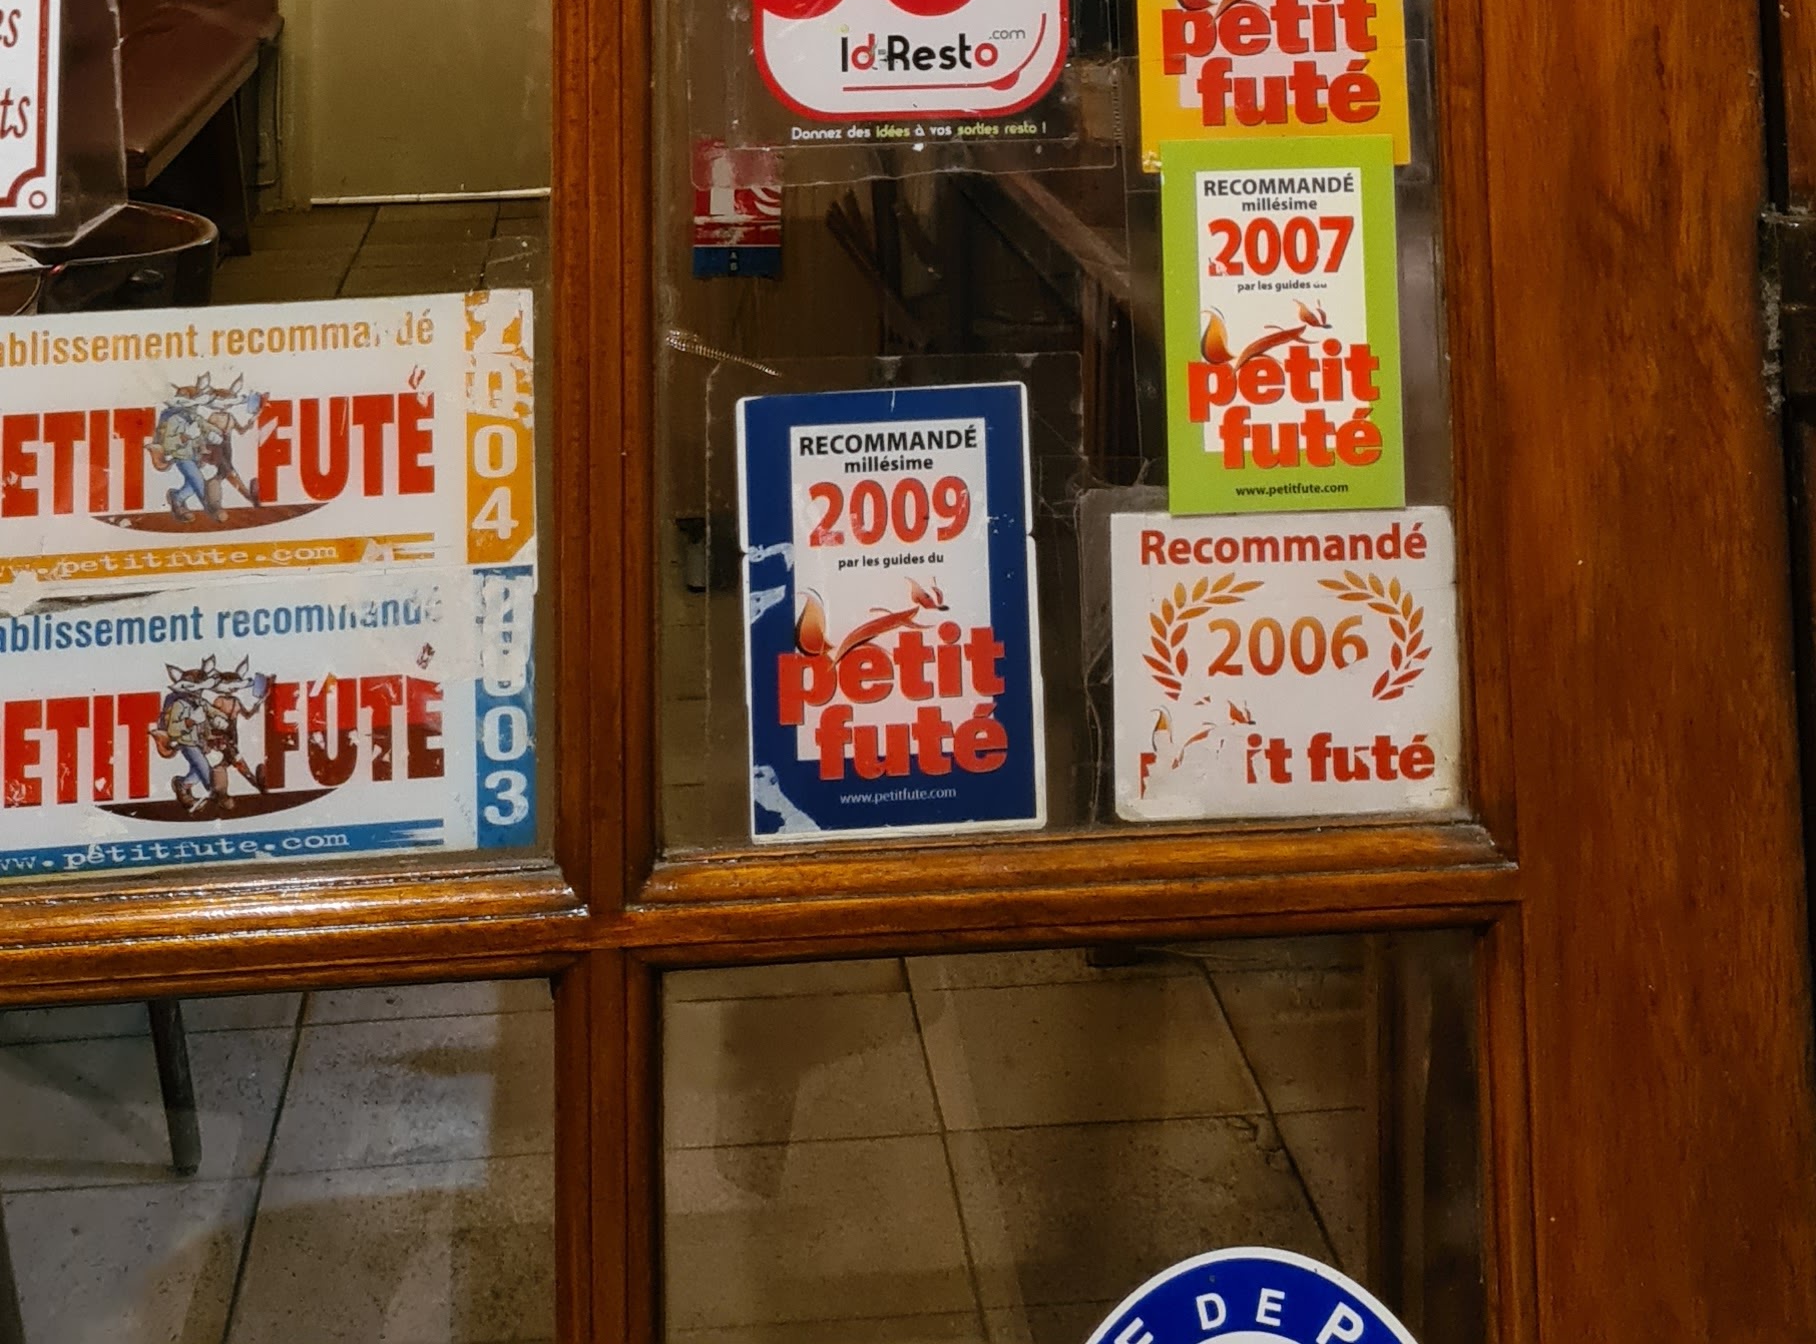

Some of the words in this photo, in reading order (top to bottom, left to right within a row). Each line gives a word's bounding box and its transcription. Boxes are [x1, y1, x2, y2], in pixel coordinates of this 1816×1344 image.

[1197, 57, 1380, 126] futé
[791, 127, 842, 140] Donnez
[847, 126, 871, 138] des
[876, 125, 910, 138] idées
[914, 124, 925, 136] à
[930, 126, 952, 136] vos
[957, 123, 999, 136] sorties
[1004, 122, 1037, 134] resto
[1204, 172, 1355, 197] RECOMMANDÉ
[1242, 197, 1317, 212] millésime
[1208, 216, 1354, 277] 2007
[1237, 283, 1255, 293] par
[1258, 281, 1273, 290] les
[1275, 280, 1311, 292] guides
[212, 309, 434, 357] recommadé
[1188, 339, 1380, 423] petit
[799, 425, 977, 456] RECOMMANDÉ
[1219, 406, 1383, 470] futé
[844, 455, 934, 474] millésime
[809, 476, 971, 547] 2009
[1236, 483, 1349, 497] www.petitfute.com
[838, 557, 859, 570] par
[862, 555, 880, 567] les
[883, 553, 925, 568] guides
[928, 552, 944, 564] du
[1140, 522, 1428, 565] Recommandé
[1208, 615, 1369, 677] 2006
[778, 621, 1005, 726] petit
[815, 703, 1008, 781] futé
[1307, 732, 1436, 782] futé
[840, 787, 957, 805] www.petitfute.com
[1195, 1287, 1286, 1331] DE
